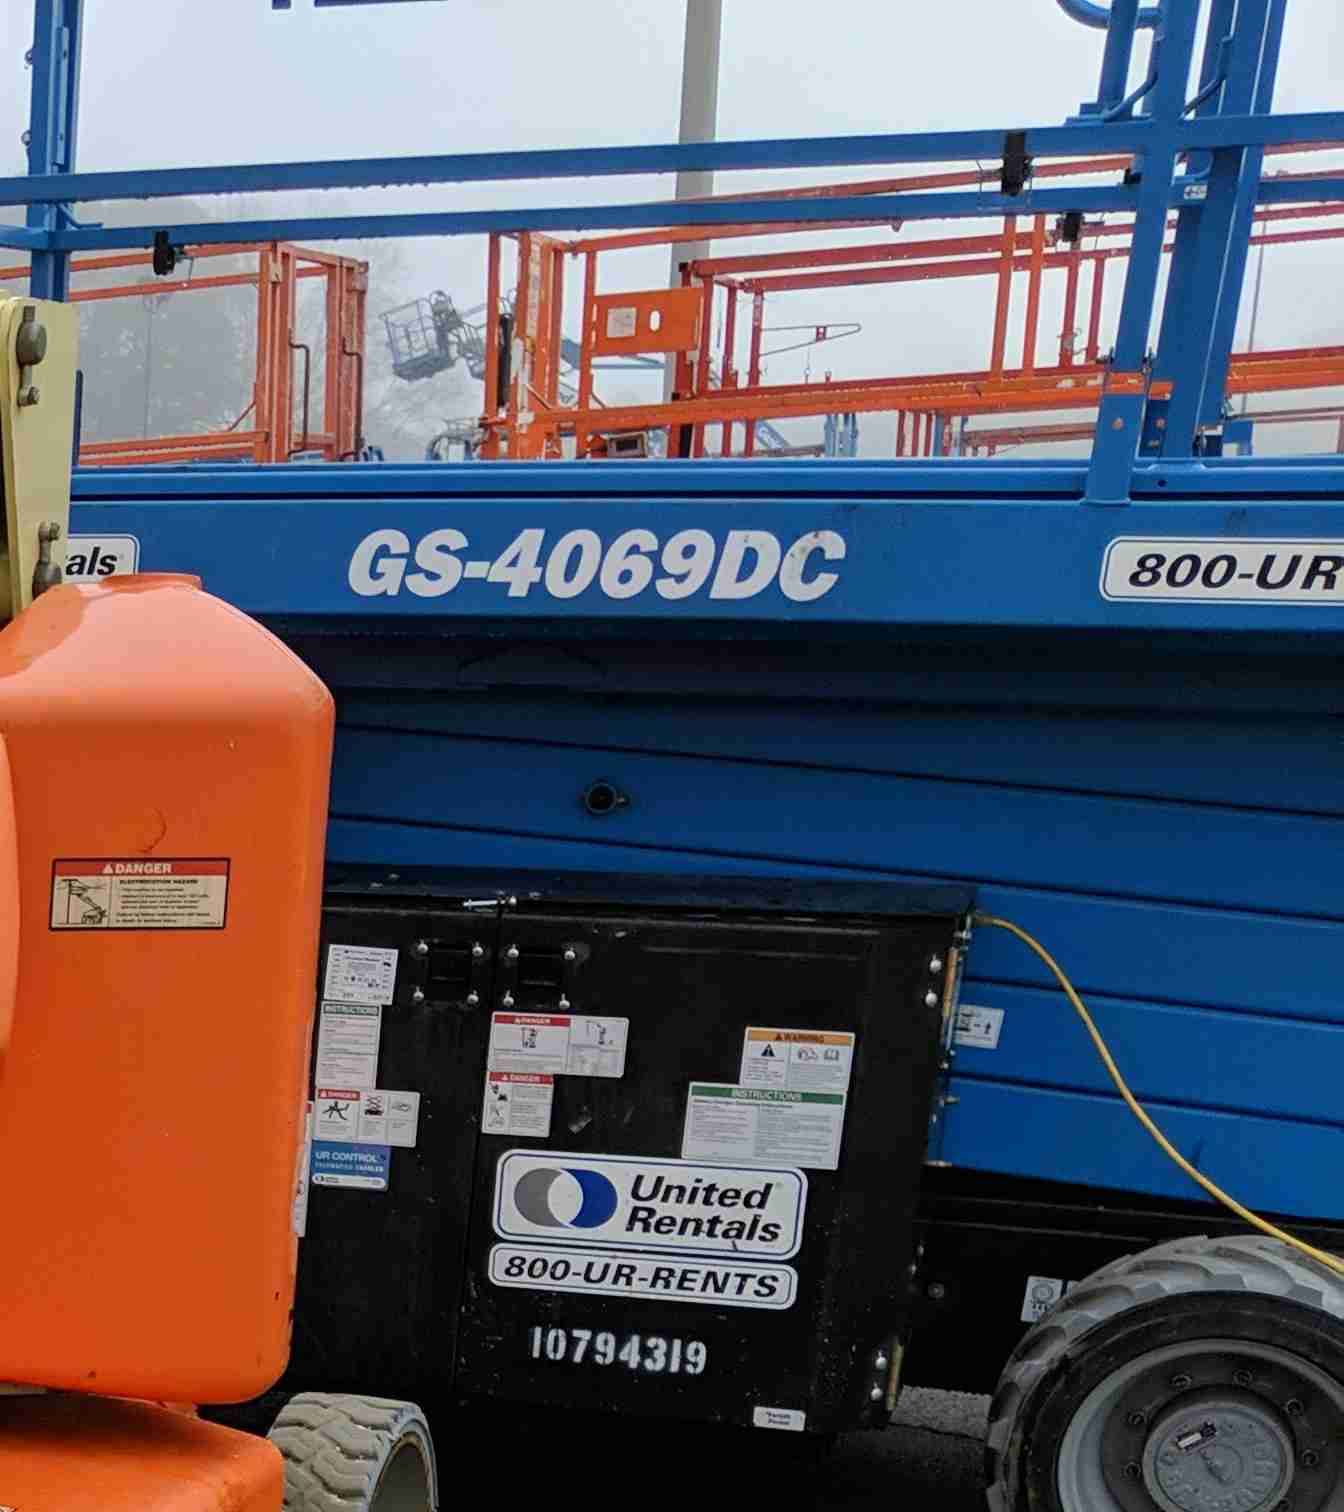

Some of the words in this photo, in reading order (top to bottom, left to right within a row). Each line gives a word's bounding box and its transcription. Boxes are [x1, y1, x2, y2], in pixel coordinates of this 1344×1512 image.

[348, 528, 844, 600] GS-4069DC
[115, 863, 172, 874] DANGER
[783, 1033, 825, 1044] WARNING
[510, 1073, 541, 1082] DANGER
[733, 1088, 802, 1102] INSTRUCTIONS
[315, 1151, 331, 1161] UR
[333, 1152, 377, 1163] CONTROL
[629, 1174, 775, 1211] United
[625, 1206, 783, 1244] Rentals
[503, 1255, 780, 1299] 800-UR-RENTS
[530, 1326, 709, 1375] 10794319
